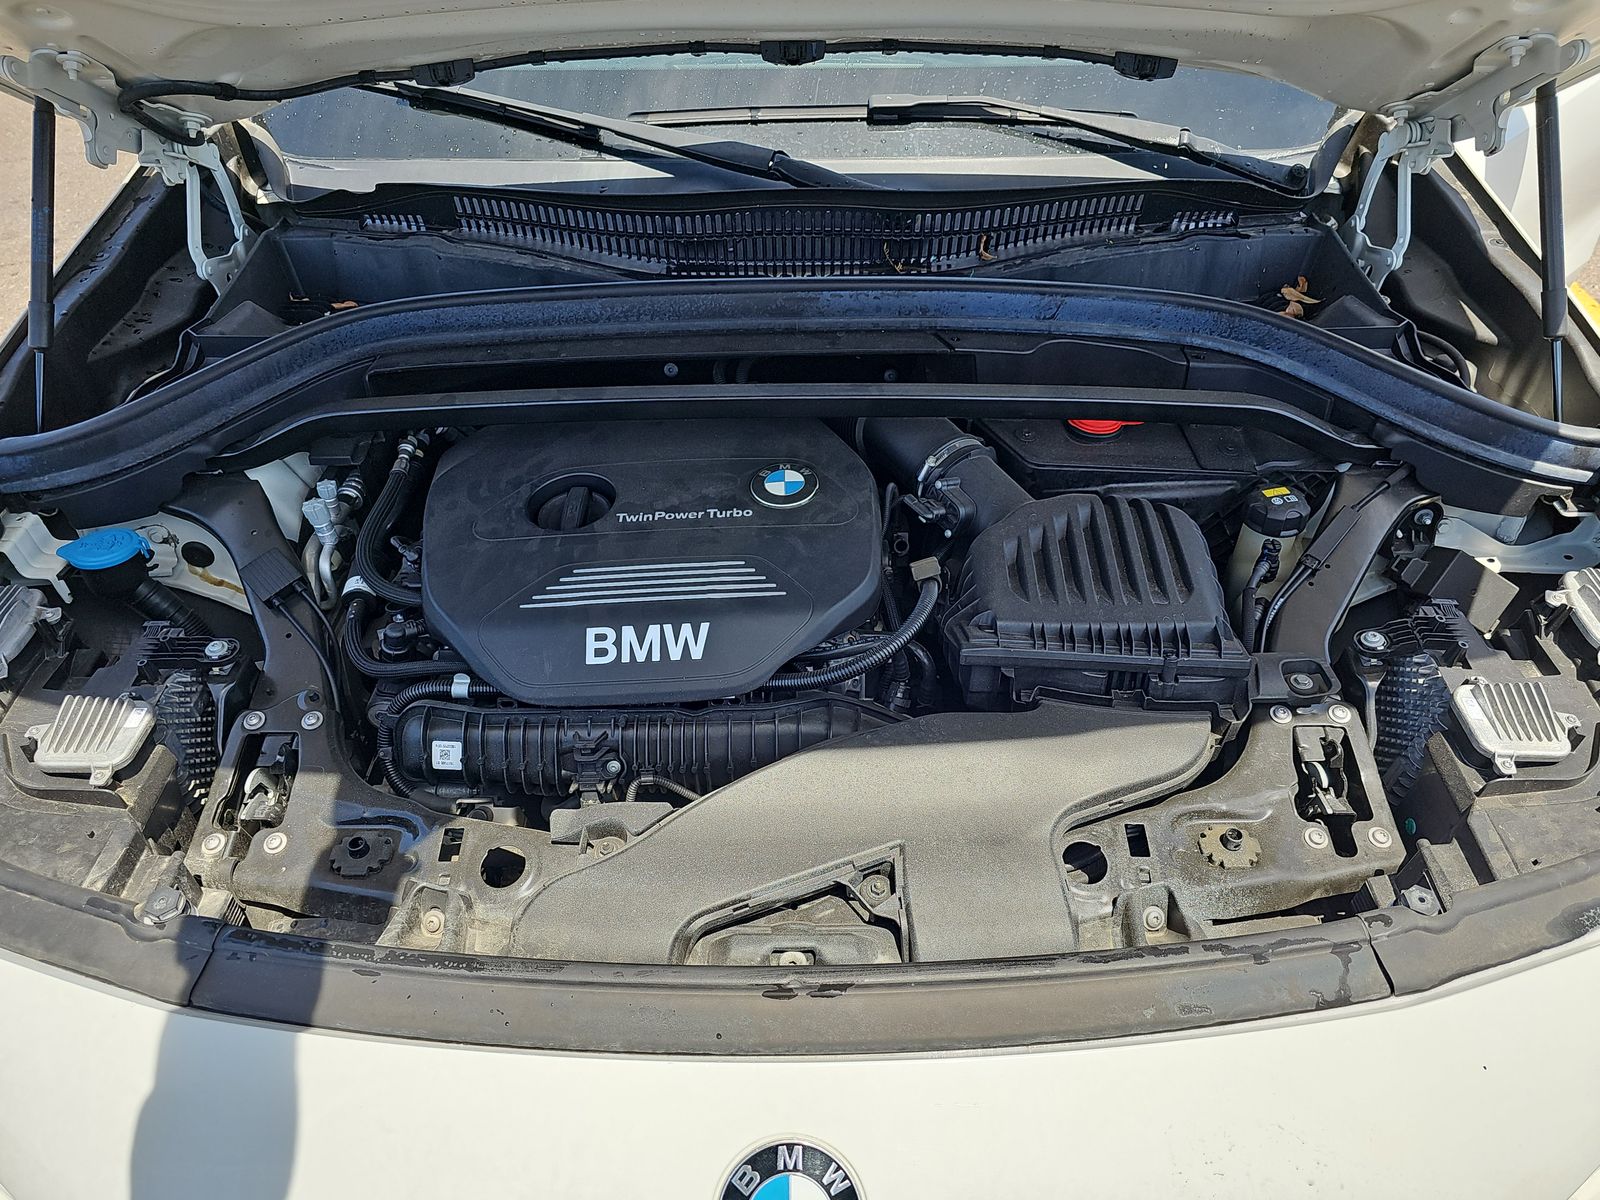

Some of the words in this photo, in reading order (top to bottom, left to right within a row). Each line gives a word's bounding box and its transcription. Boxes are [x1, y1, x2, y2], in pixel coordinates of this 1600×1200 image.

[759, 464, 812, 477] BMW
[707, 508, 753, 519] Turbo
[585, 622, 710, 665] BMW
[731, 1145, 851, 1197] BMW
